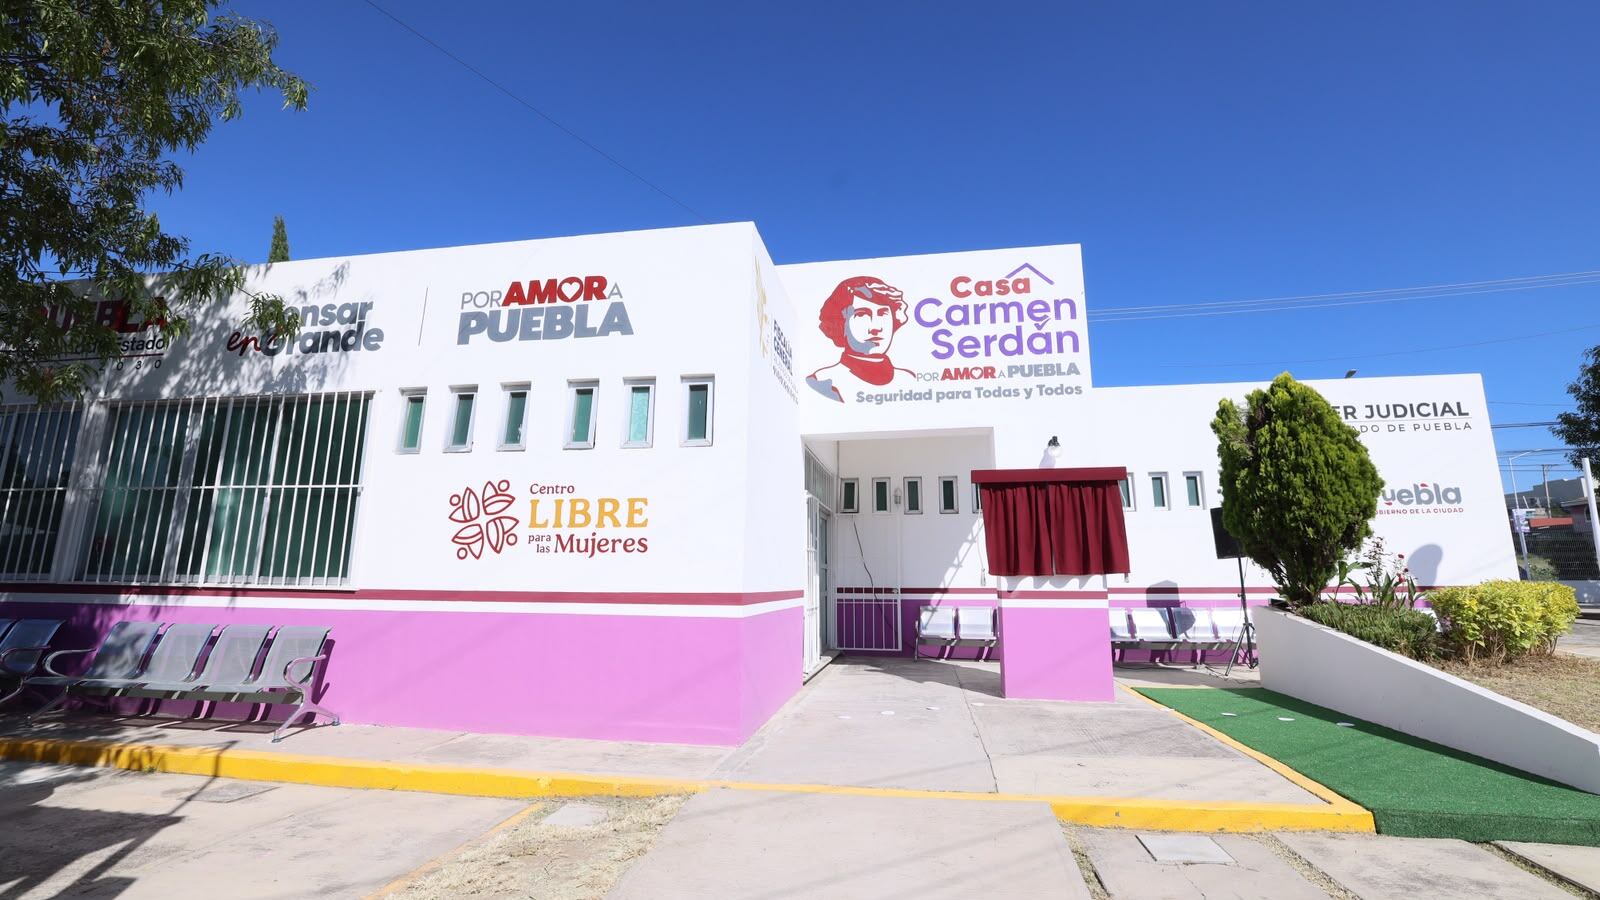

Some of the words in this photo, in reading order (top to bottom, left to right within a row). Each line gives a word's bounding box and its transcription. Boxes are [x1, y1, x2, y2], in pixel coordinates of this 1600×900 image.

[460, 290, 503, 310] POR
[502, 275, 608, 307] AMOR
[607, 282, 624, 300] A
[950, 276, 1031, 298] Casa
[457, 301, 634, 345] PUEBLA
[914, 297, 1077, 328] Carmen
[112, 334, 165, 352] stado
[916, 372, 940, 382] POR
[940, 366, 996, 381] AMOR
[997, 370, 1006, 379] A
[1007, 362, 1081, 379] PUEBLA
[855, 388, 933, 405] Seguridad
[935, 390, 972, 403] para
[974, 385, 1021, 399] Todas
[1023, 387, 1033, 400] y
[1036, 382, 1083, 396] Todos
[1365, 401, 1469, 419] JUDICIAL
[1387, 423, 1406, 432] DE
[1413, 422, 1472, 432] PUEBLA
[529, 483, 575, 495] Centro
[1381, 483, 1462, 506] uebla
[528, 497, 649, 529] LIBRE
[528, 534, 551, 544] para
[536, 544, 550, 553] las
[554, 532, 648, 558] Mujeres
